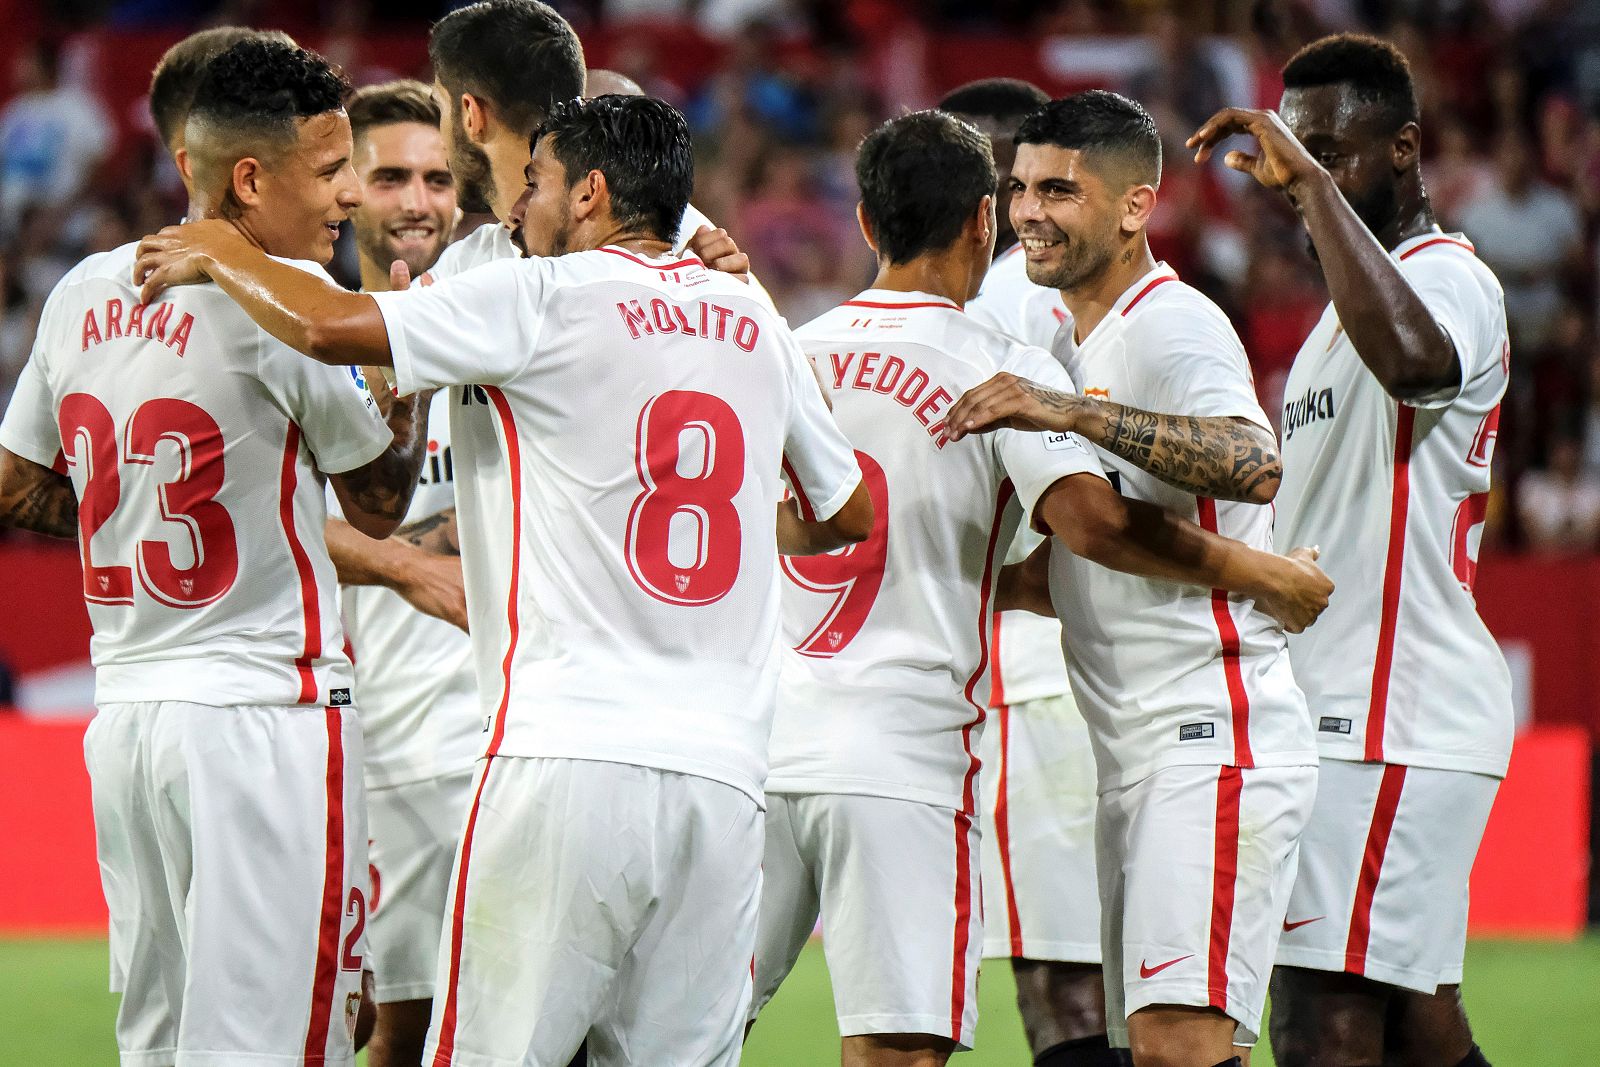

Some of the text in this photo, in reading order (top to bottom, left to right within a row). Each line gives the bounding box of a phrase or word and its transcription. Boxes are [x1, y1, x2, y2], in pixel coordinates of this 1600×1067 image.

[82, 298, 195, 358] ARANA
[616, 298, 760, 352] NOLITO
[58, 392, 238, 609] 23
[624, 389, 745, 607] 8
[778, 449, 889, 659] 9
